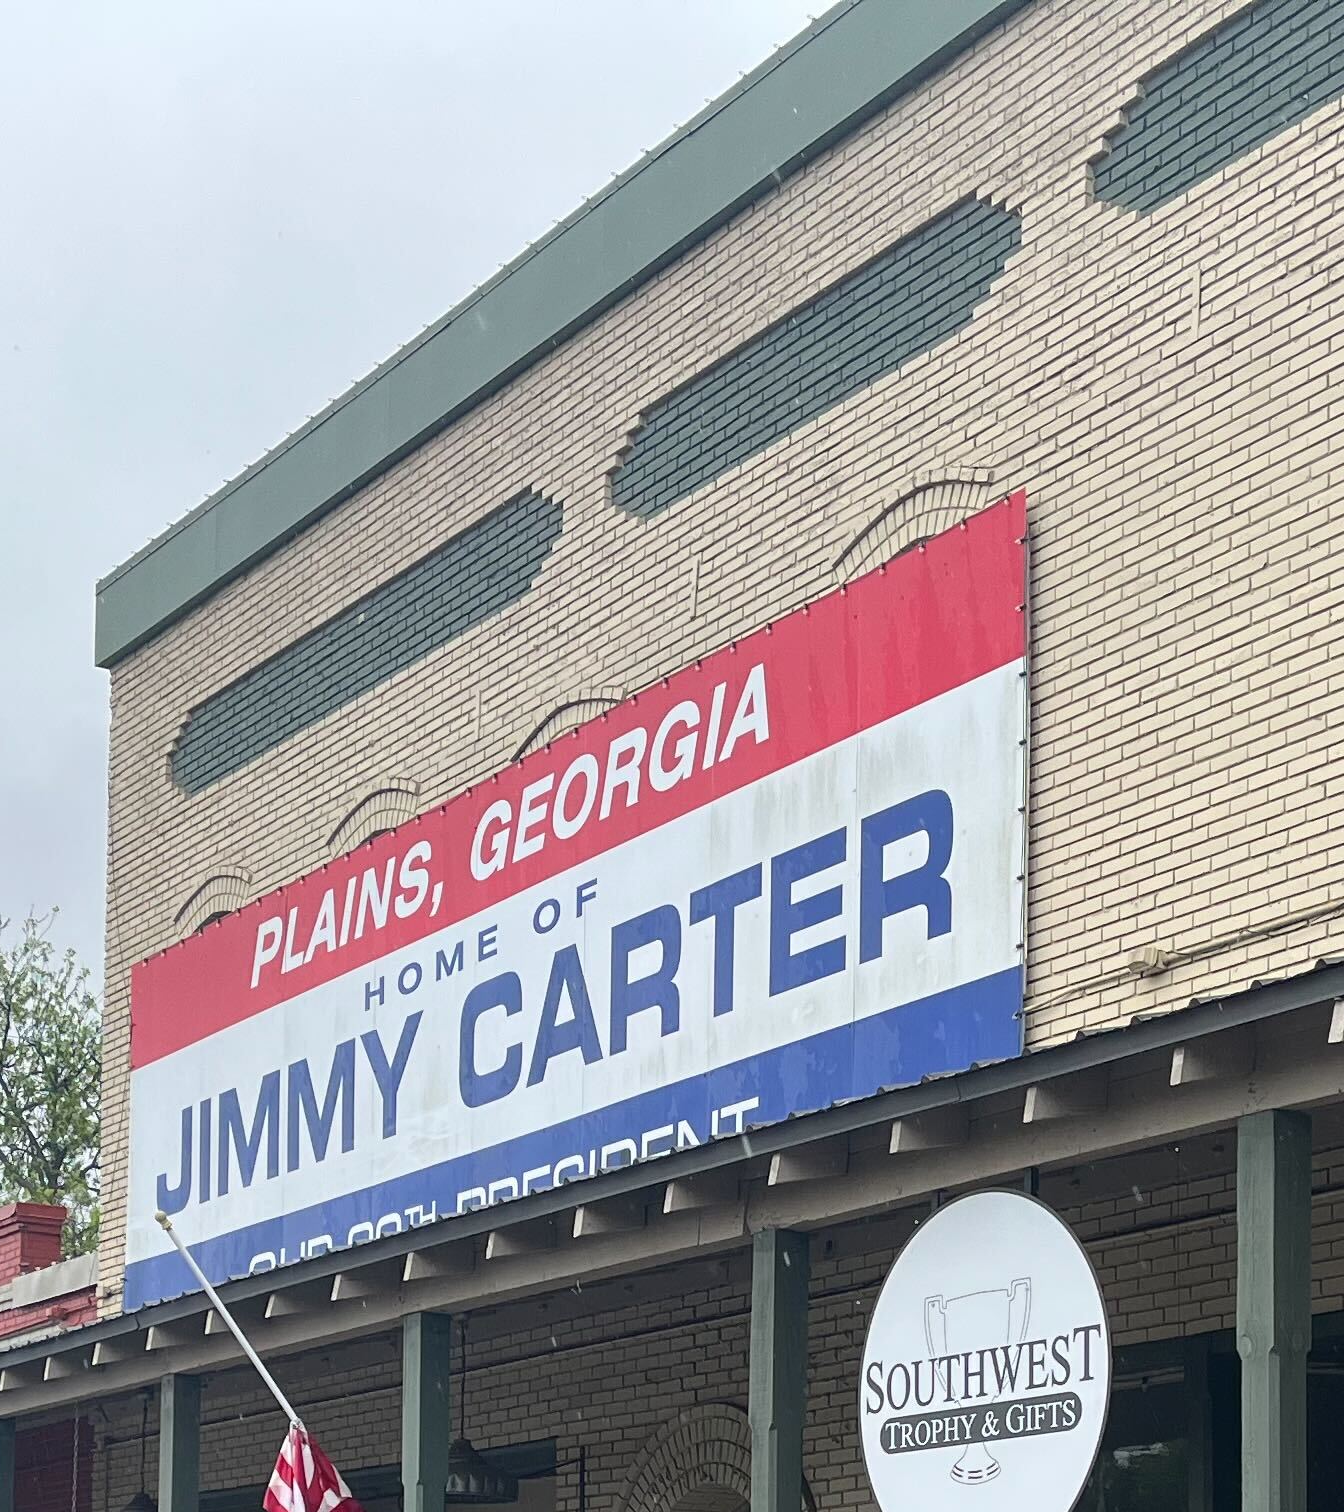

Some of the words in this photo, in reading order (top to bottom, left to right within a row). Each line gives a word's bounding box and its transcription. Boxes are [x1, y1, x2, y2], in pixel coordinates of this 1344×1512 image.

[250, 840, 445, 988] PLAINS,
[469, 662, 770, 882] GEORGIA
[156, 1010, 424, 1215] JIMMY
[458, 789, 954, 1109] CARTER
[364, 924, 498, 1012] HOME
[533, 877, 598, 935] OF
[866, 1323, 1102, 1415] SOUTHWEST
[885, 1413, 977, 1450] TROPHY
[981, 1410, 1000, 1437] &
[1005, 1399, 1076, 1434] GIFTS
